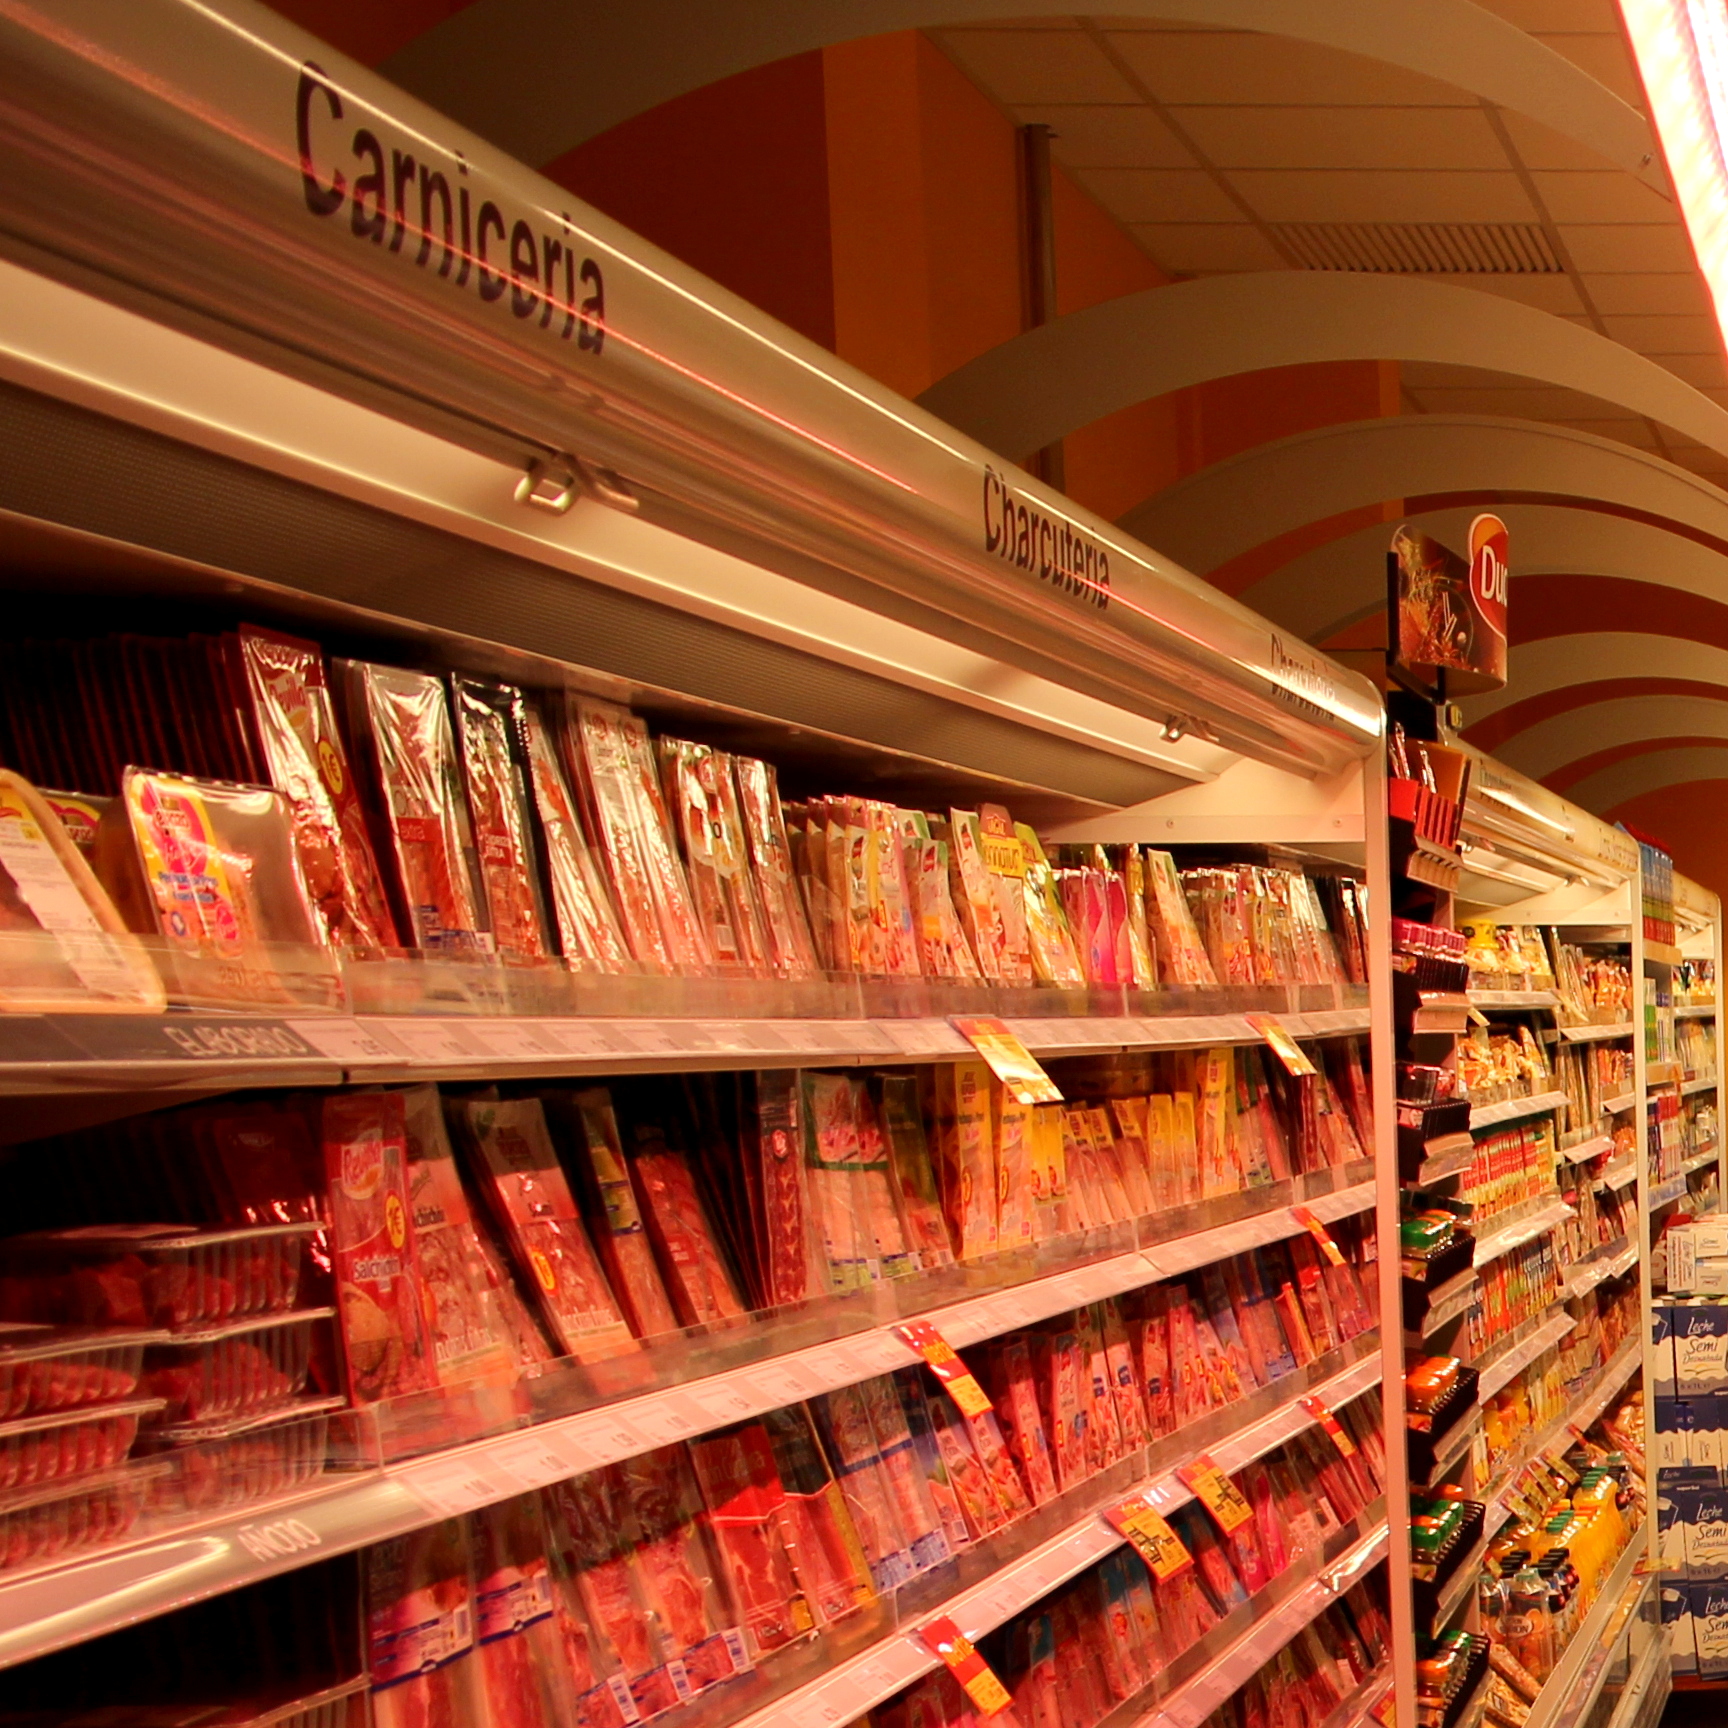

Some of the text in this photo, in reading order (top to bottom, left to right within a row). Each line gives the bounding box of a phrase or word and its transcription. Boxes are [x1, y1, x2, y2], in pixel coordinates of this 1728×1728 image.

[1689, 1338, 1717, 1352] Semi
[237, 1519, 322, 1561] AÑOJO
[1696, 1524, 1727, 1540] Semi
